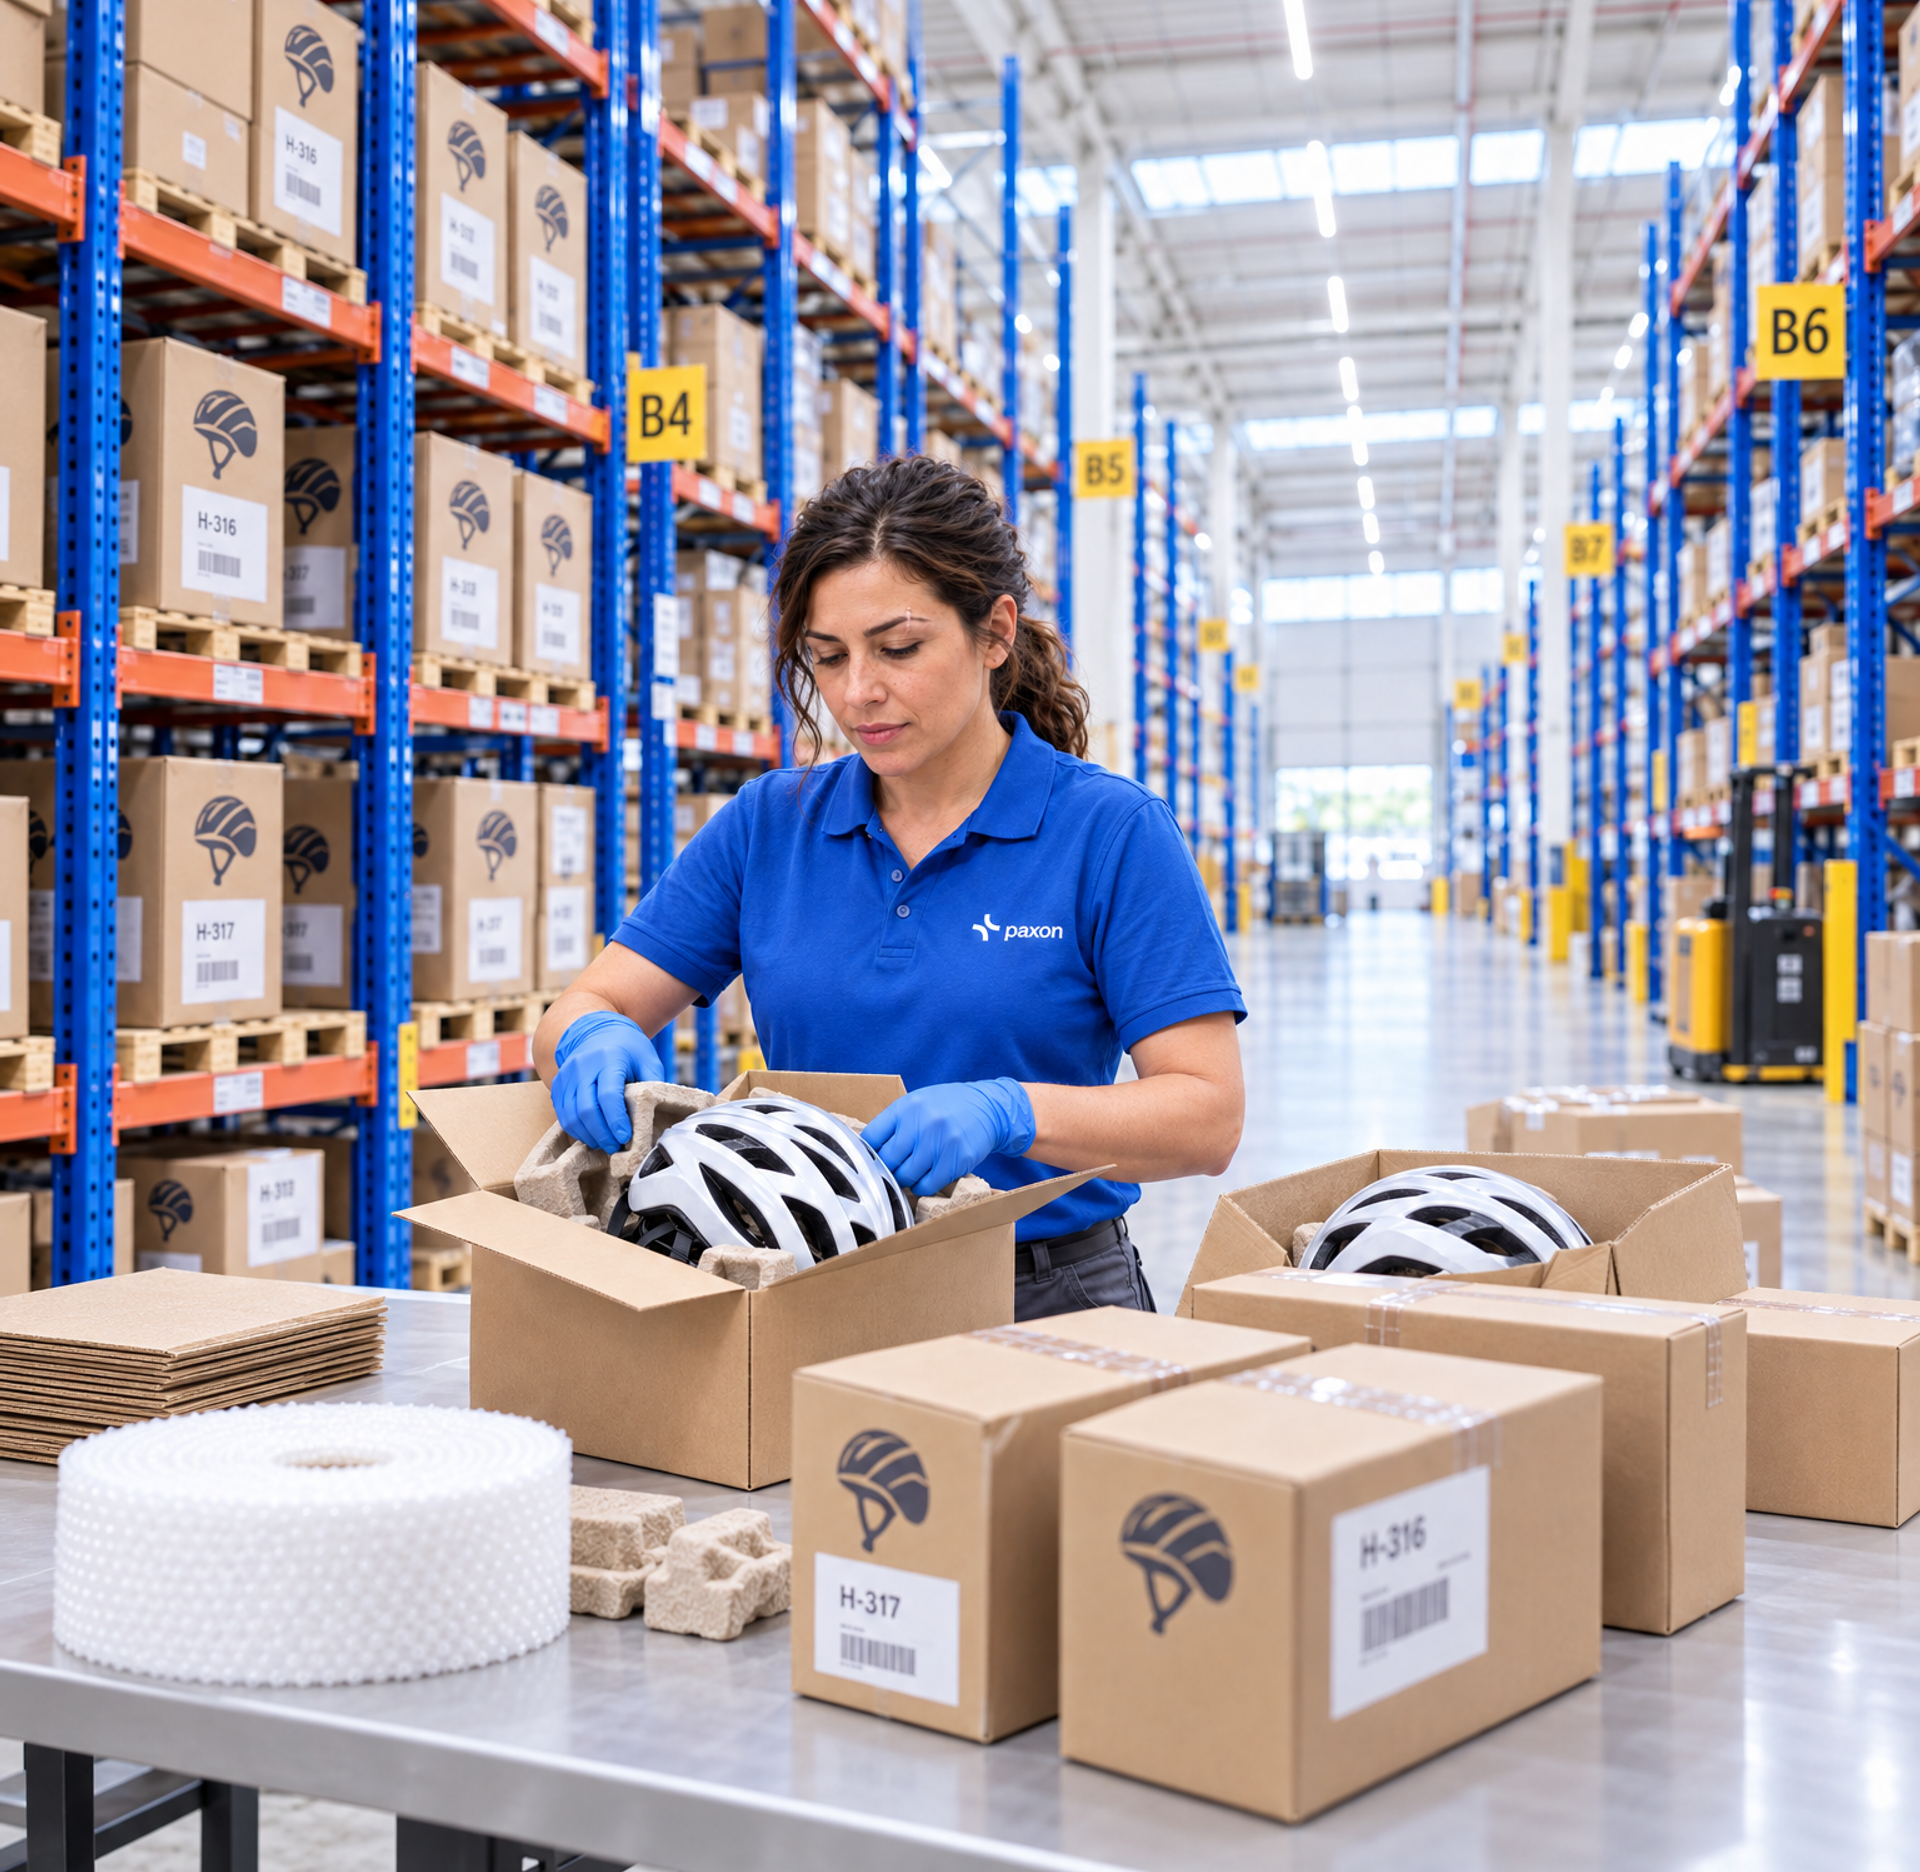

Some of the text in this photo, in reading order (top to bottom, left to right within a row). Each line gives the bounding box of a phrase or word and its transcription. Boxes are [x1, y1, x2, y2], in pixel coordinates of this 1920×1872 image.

[285, 133, 318, 165] H-316
[1773, 307, 1828, 354] B6
[641, 391, 691, 438] B4
[1086, 453, 1124, 486] B5
[198, 511, 237, 536] H-316
[1571, 534, 1606, 565] B7
[196, 922, 235, 941] H-317
[1004, 925, 1063, 941] paxon
[1360, 1514, 1426, 1571] H-316
[840, 1585, 901, 1618] H-317
